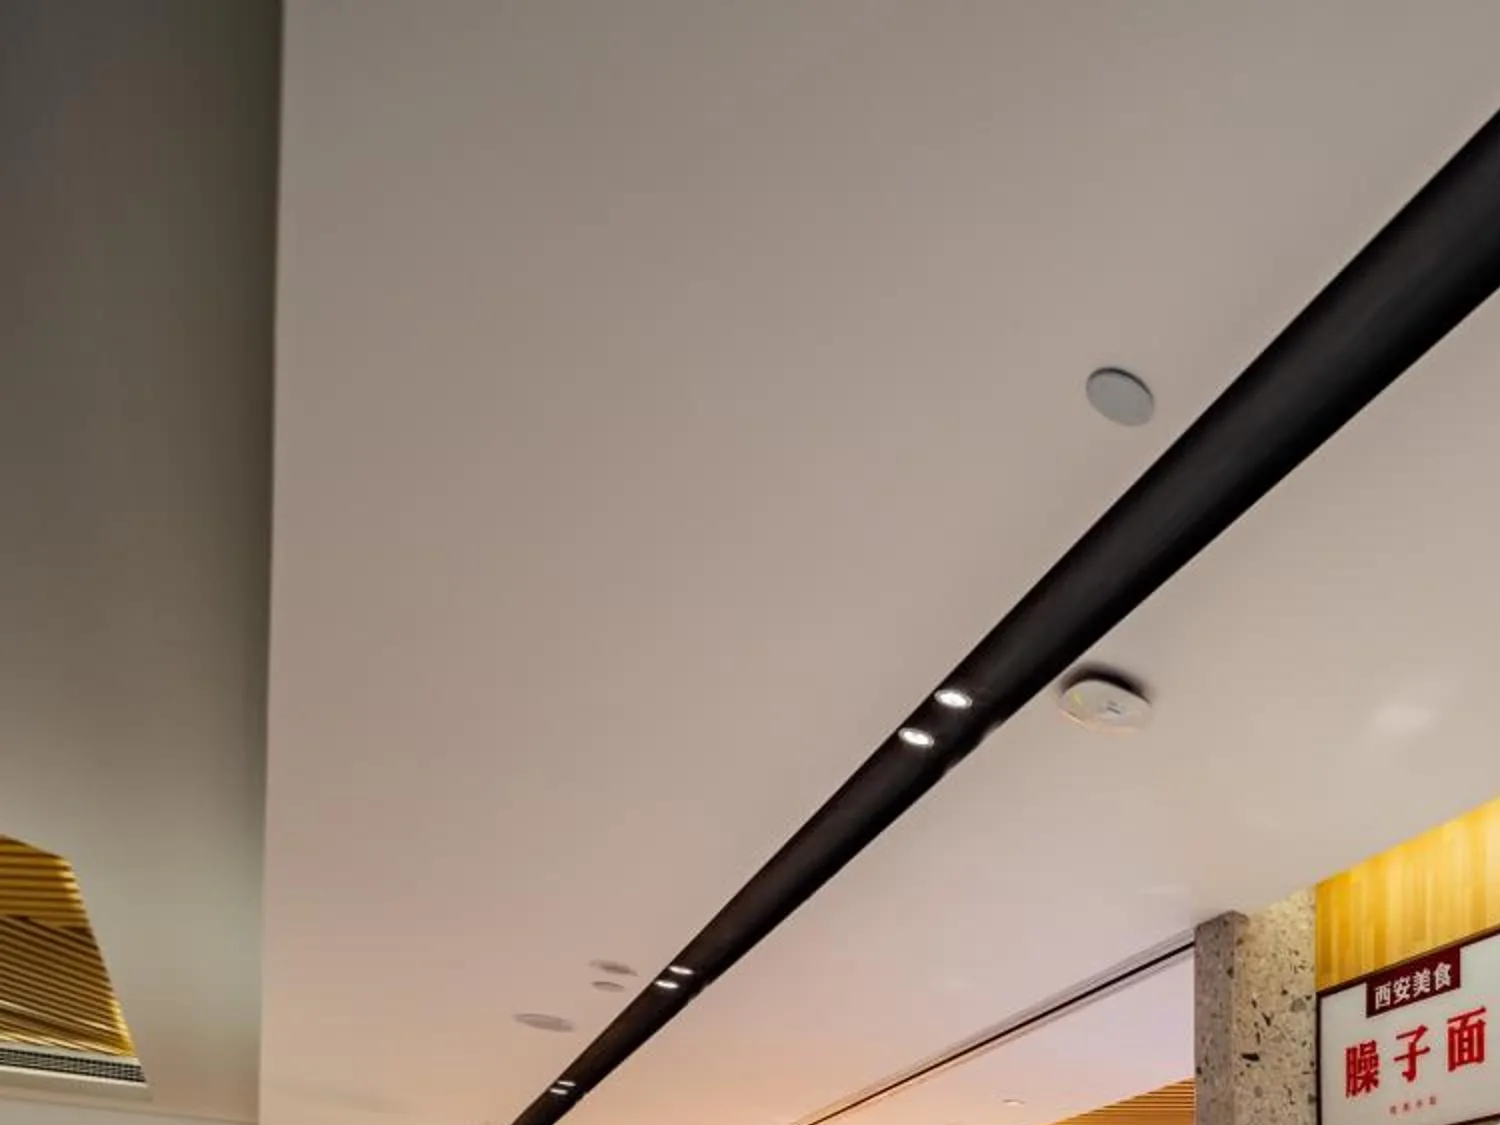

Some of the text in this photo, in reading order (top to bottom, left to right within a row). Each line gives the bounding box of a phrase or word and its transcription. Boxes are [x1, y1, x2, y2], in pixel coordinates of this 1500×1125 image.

[1374, 961, 1452, 1010] 西安美食
[1345, 1005, 1486, 1098] 臊子面
